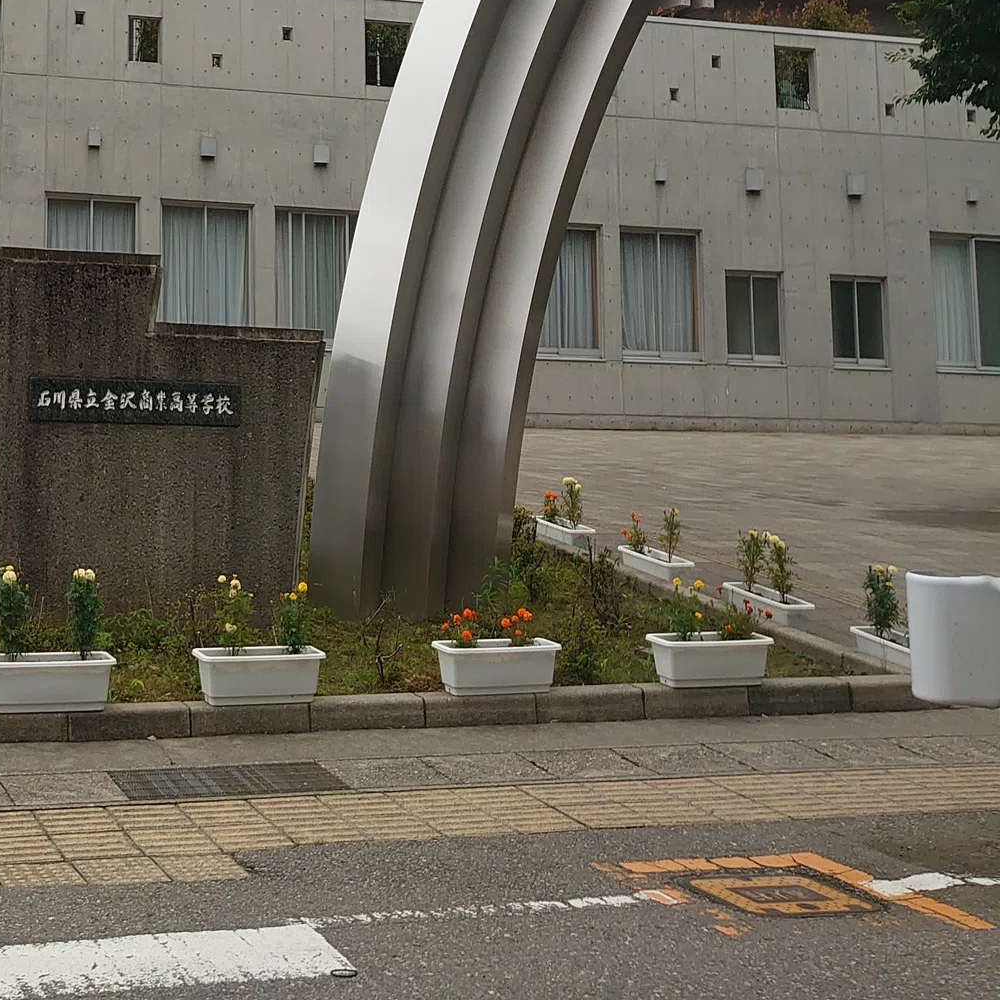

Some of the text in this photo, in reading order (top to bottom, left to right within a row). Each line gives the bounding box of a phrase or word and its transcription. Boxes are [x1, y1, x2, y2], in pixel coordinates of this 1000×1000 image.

[37, 388, 234, 415] 石川県立金沢商業高等学校
